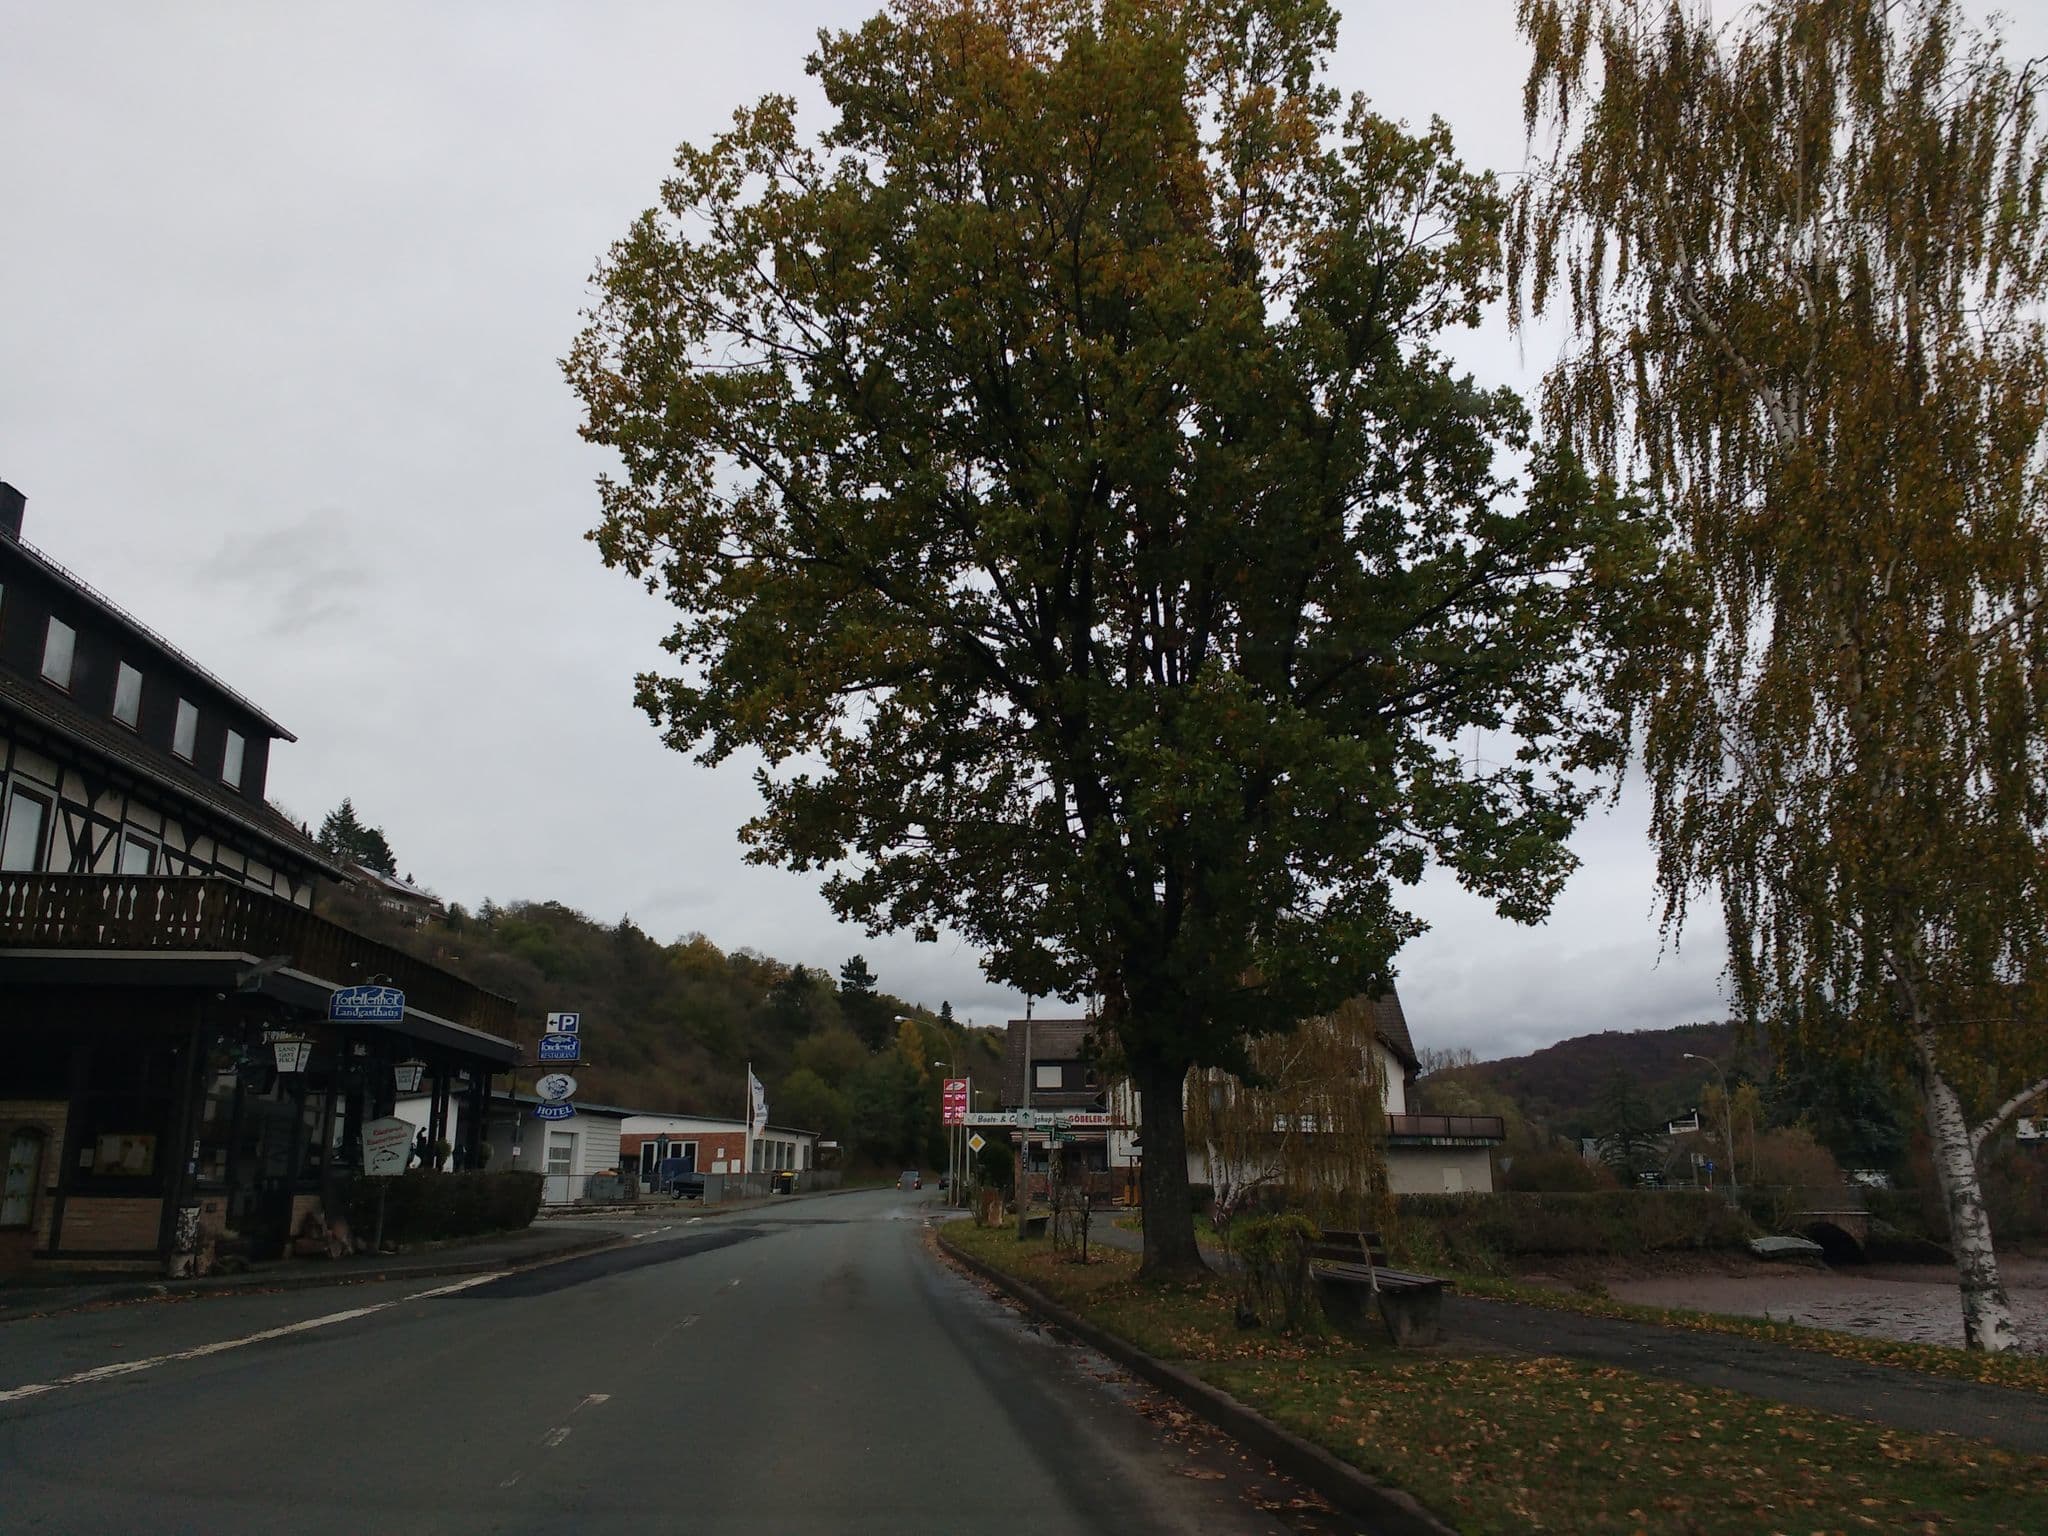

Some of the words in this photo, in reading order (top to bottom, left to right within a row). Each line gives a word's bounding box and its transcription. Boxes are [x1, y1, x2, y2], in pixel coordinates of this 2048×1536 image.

[335, 1007, 400, 1018] Landgasthaus
[561, 1015, 576, 1031] P
[537, 1105, 573, 1117] HOTEL
